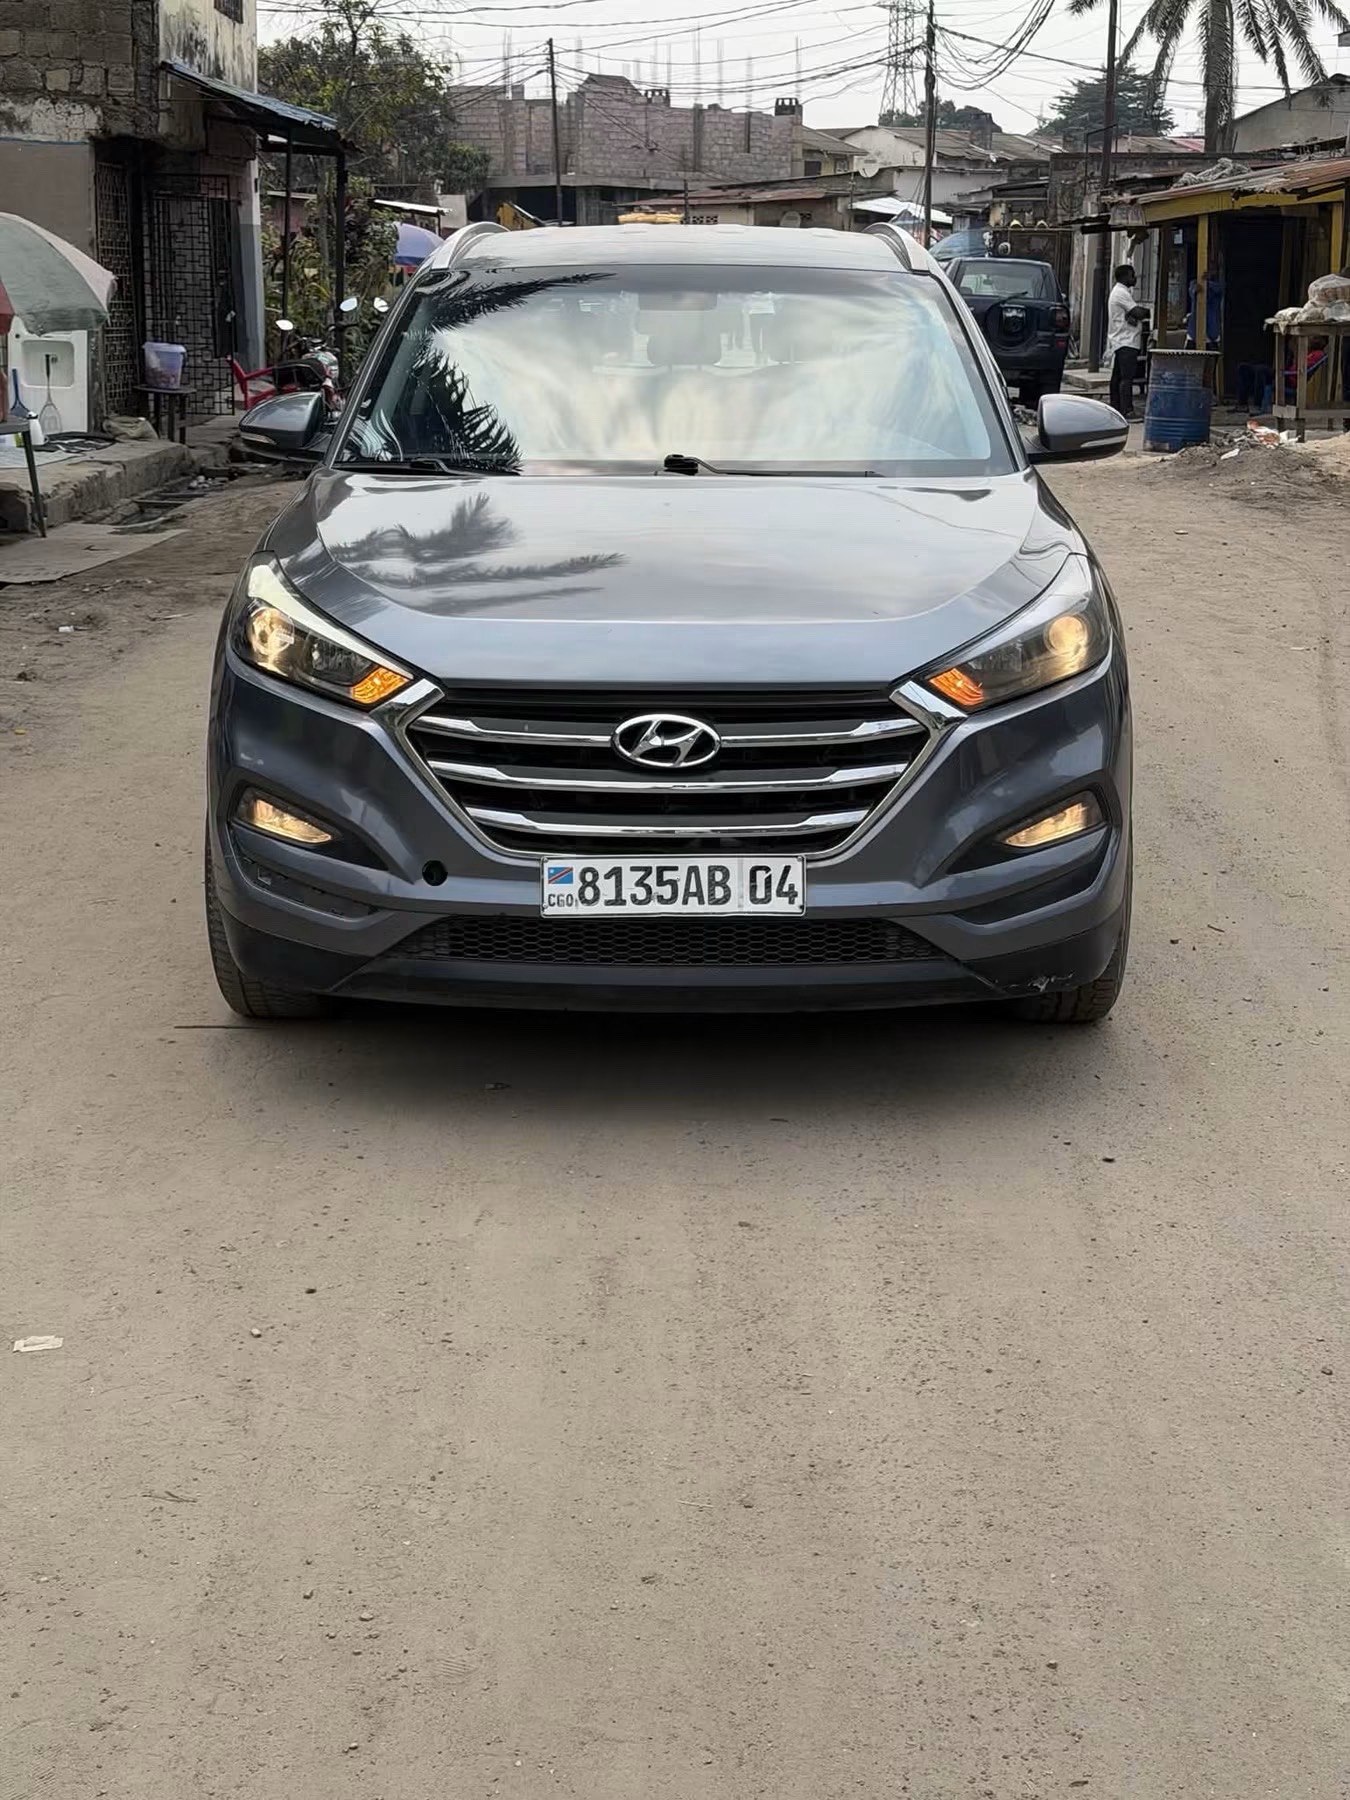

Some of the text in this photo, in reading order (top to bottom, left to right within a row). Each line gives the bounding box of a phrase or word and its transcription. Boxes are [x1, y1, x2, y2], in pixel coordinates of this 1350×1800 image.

[578, 865, 799, 907] 8135AB 04
[547, 893, 574, 908] CGO
